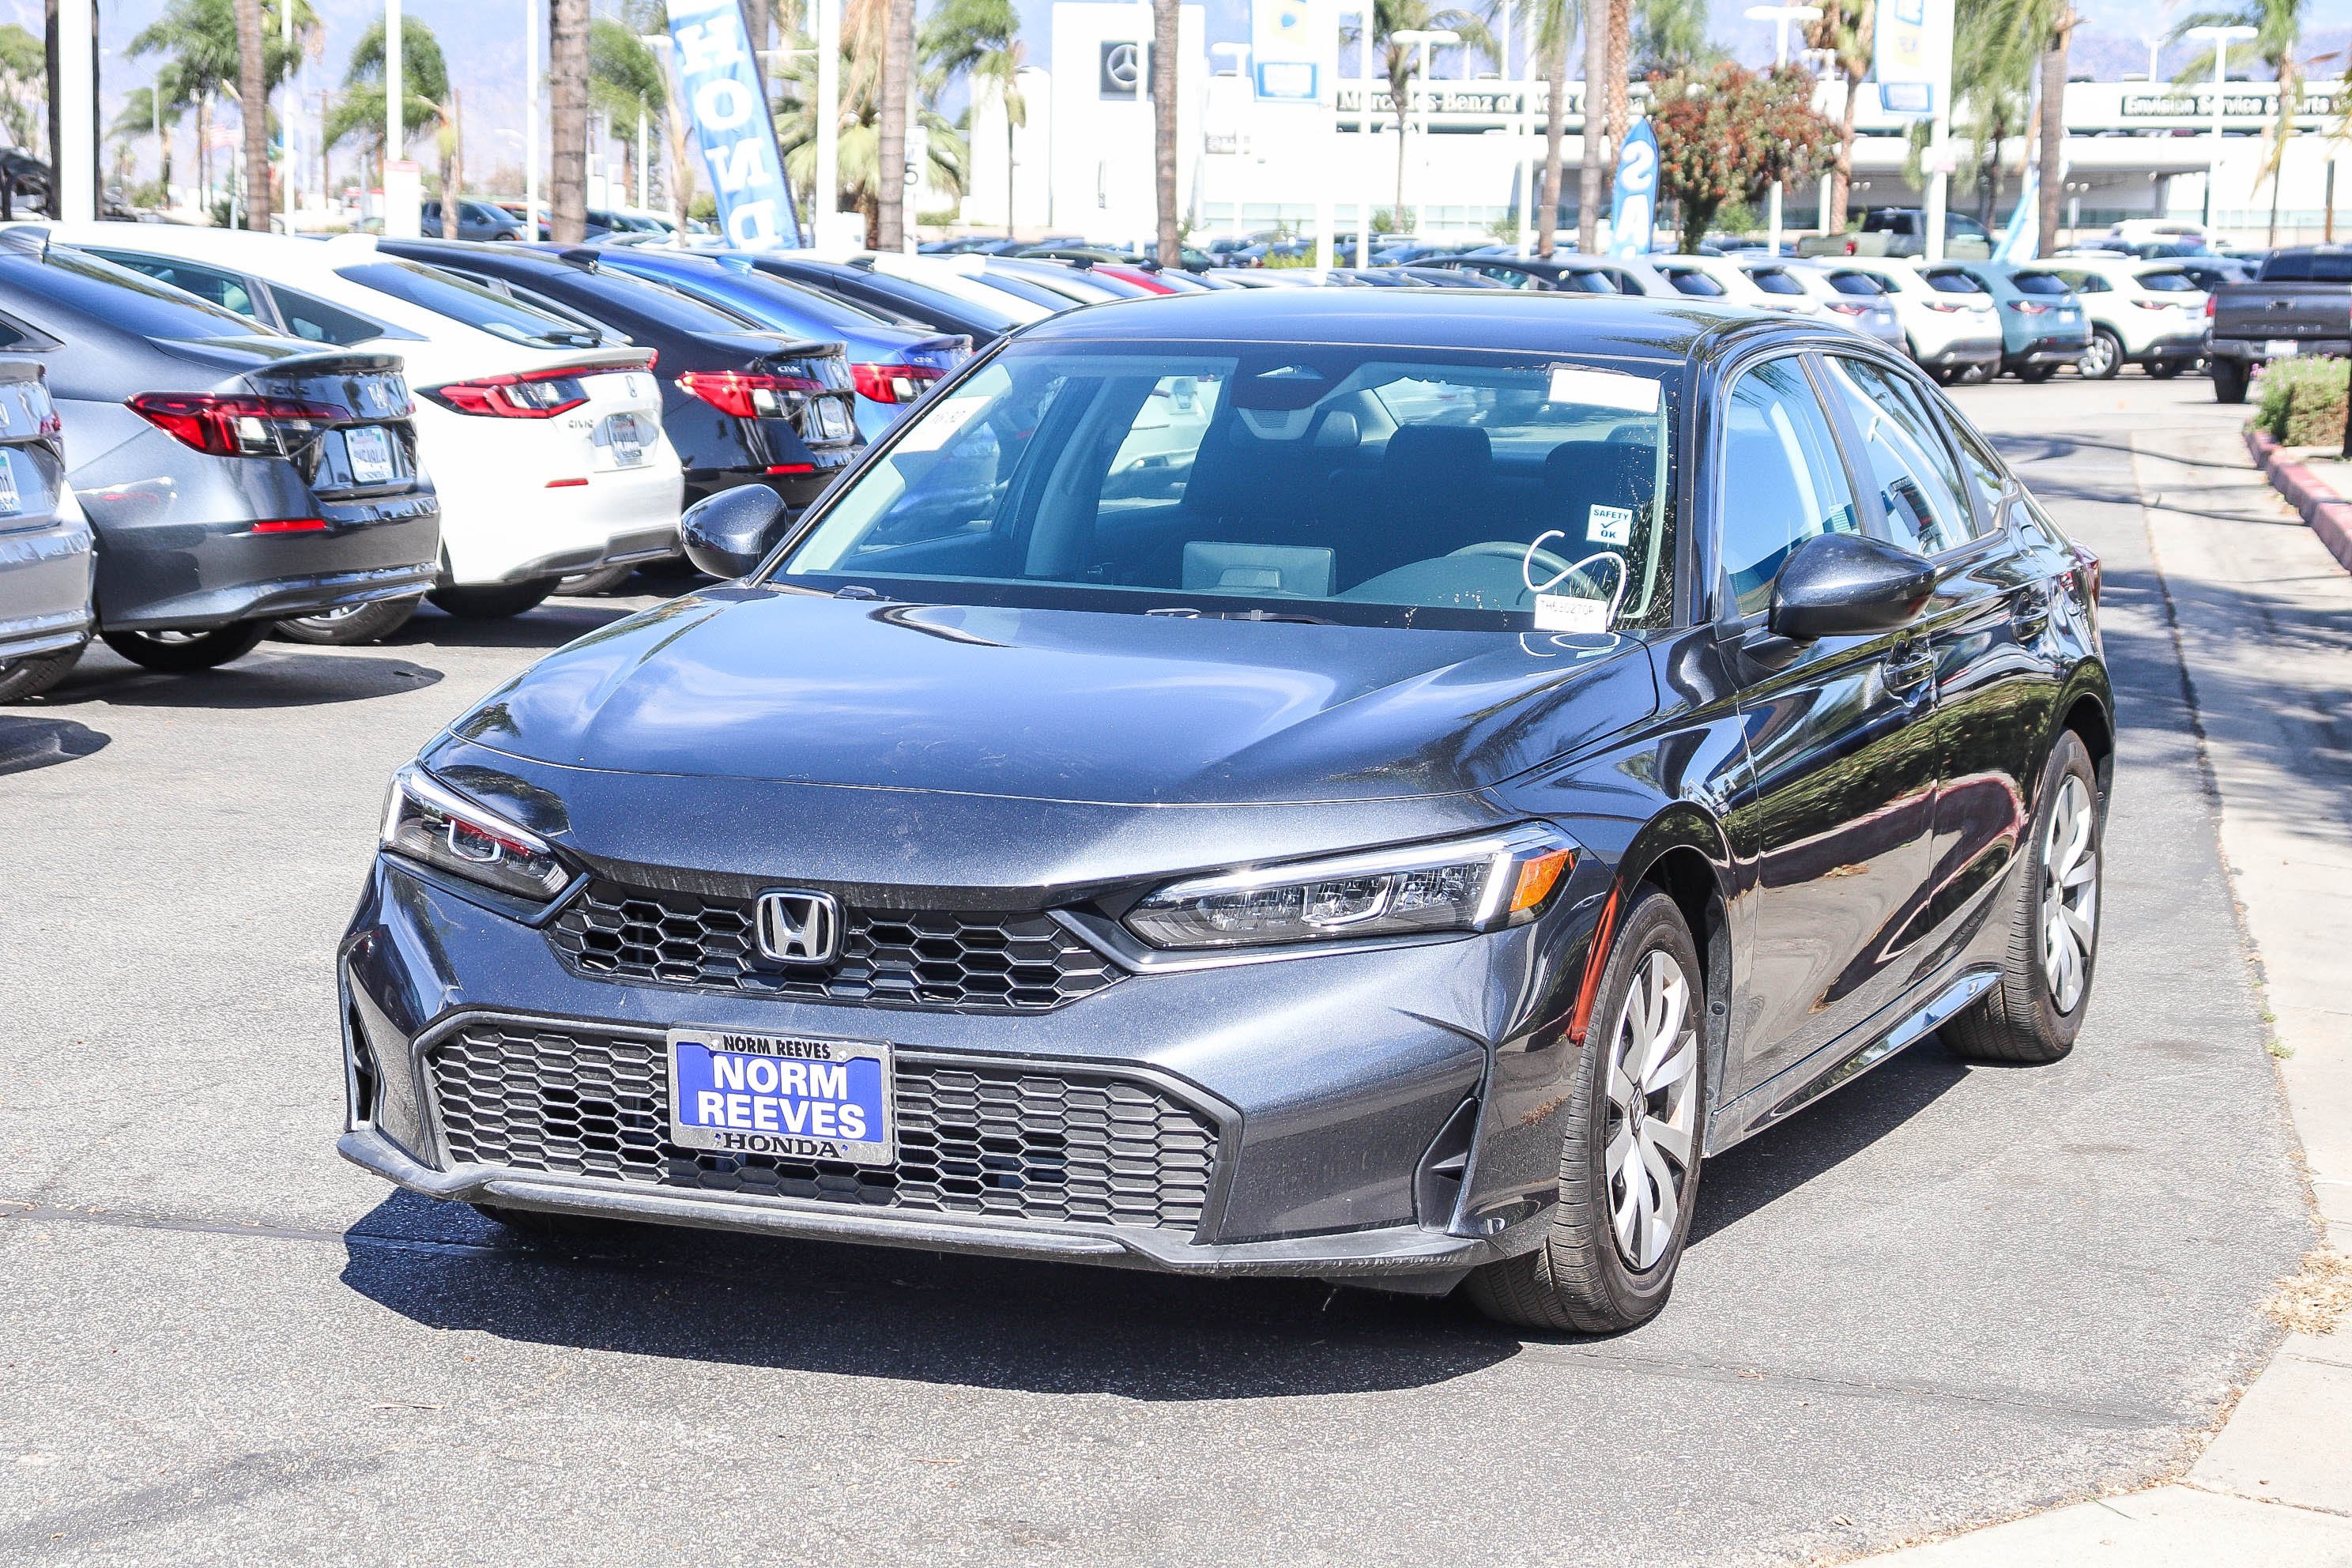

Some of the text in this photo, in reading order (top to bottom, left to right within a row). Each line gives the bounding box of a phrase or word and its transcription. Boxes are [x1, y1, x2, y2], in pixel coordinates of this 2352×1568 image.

[568, 420, 594, 428] CIVIC
[1593, 508, 1630, 521] SAFETY
[1600, 530, 1617, 539] OK
[722, 1035, 831, 1060] NORM REEVES
[712, 1055, 848, 1101] NORM
[697, 1090, 867, 1140] REEVES
[722, 1132, 843, 1159] HONDA
